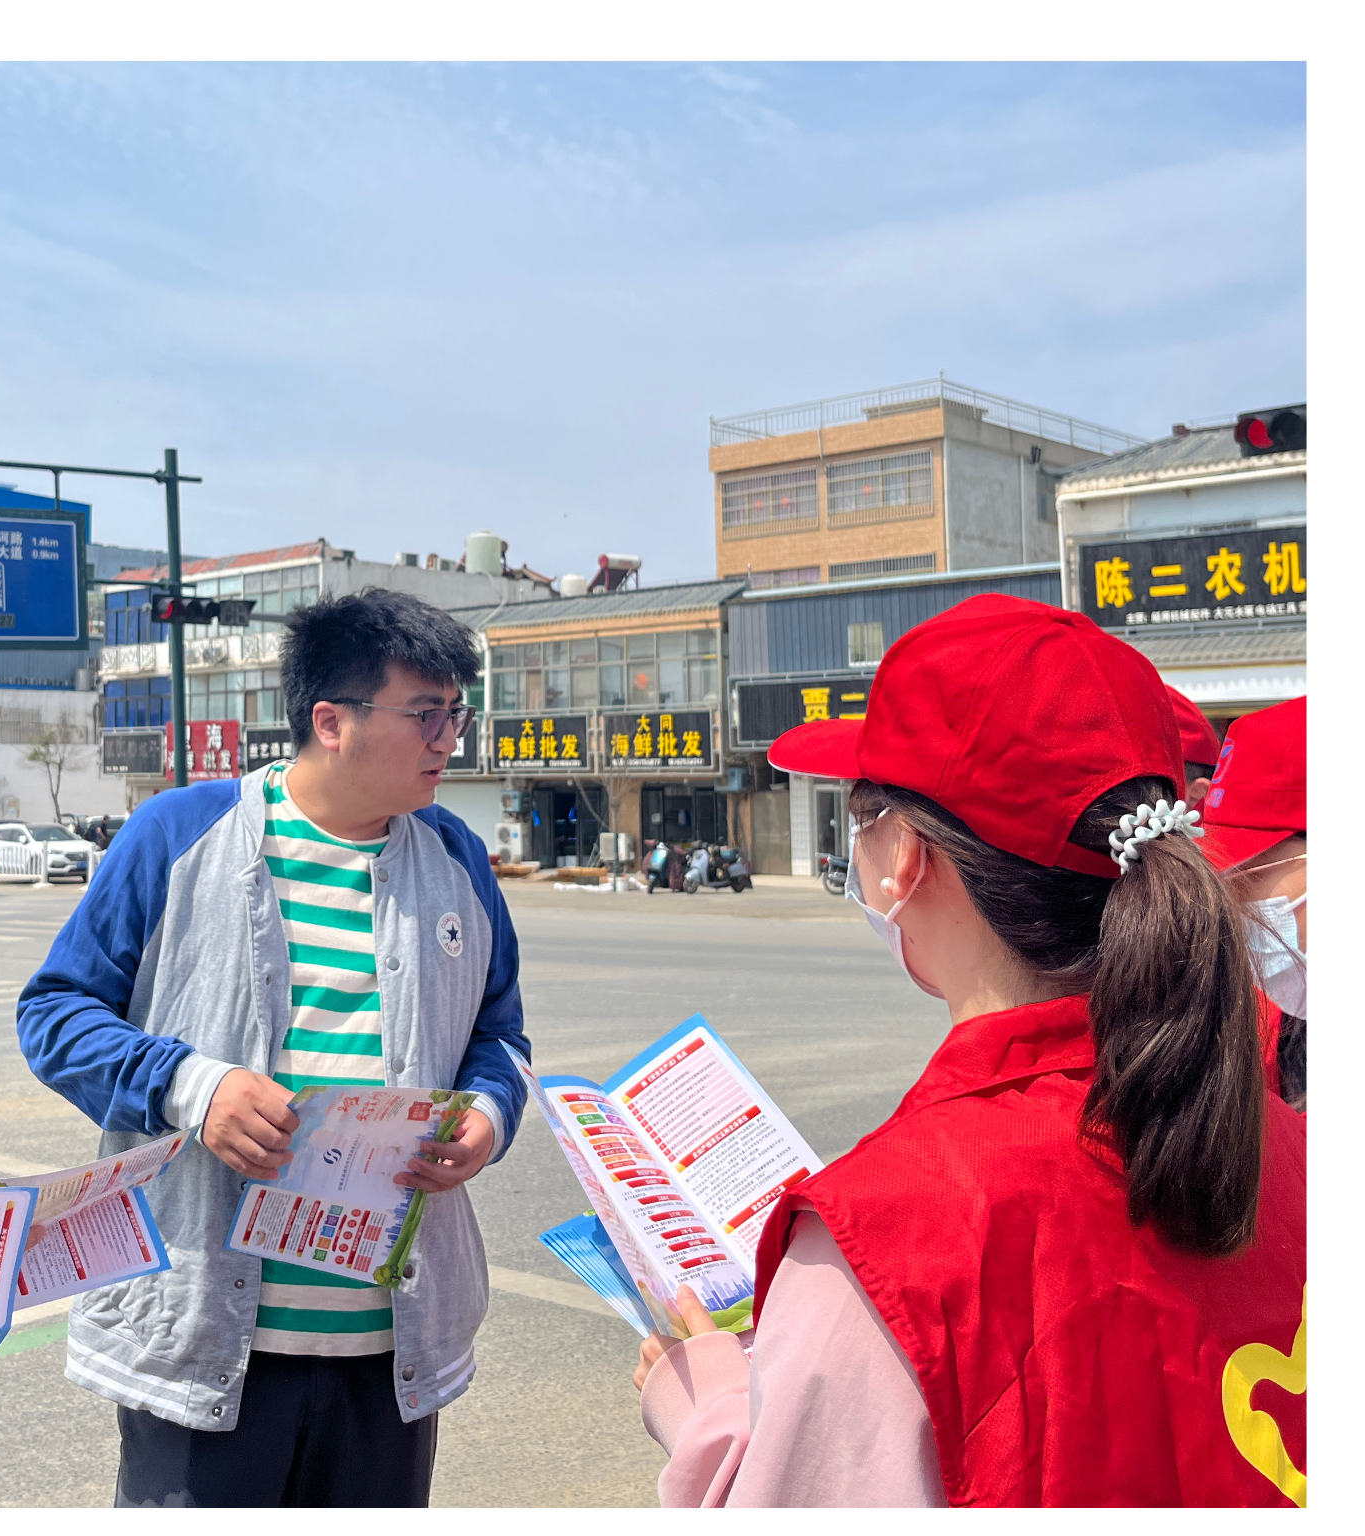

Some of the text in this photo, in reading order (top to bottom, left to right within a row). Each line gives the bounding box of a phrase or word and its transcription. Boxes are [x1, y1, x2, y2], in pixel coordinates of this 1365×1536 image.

[31, 537, 59, 547] 1.4km
[32, 549, 59, 561] 0.9km
[1095, 541, 1306, 608] 陈二农机
[521, 719, 555, 735] 大郑
[637, 715, 674, 732] 大同
[498, 735, 579, 759] 海鲜批发
[611, 731, 702, 757] 海鲜批发
